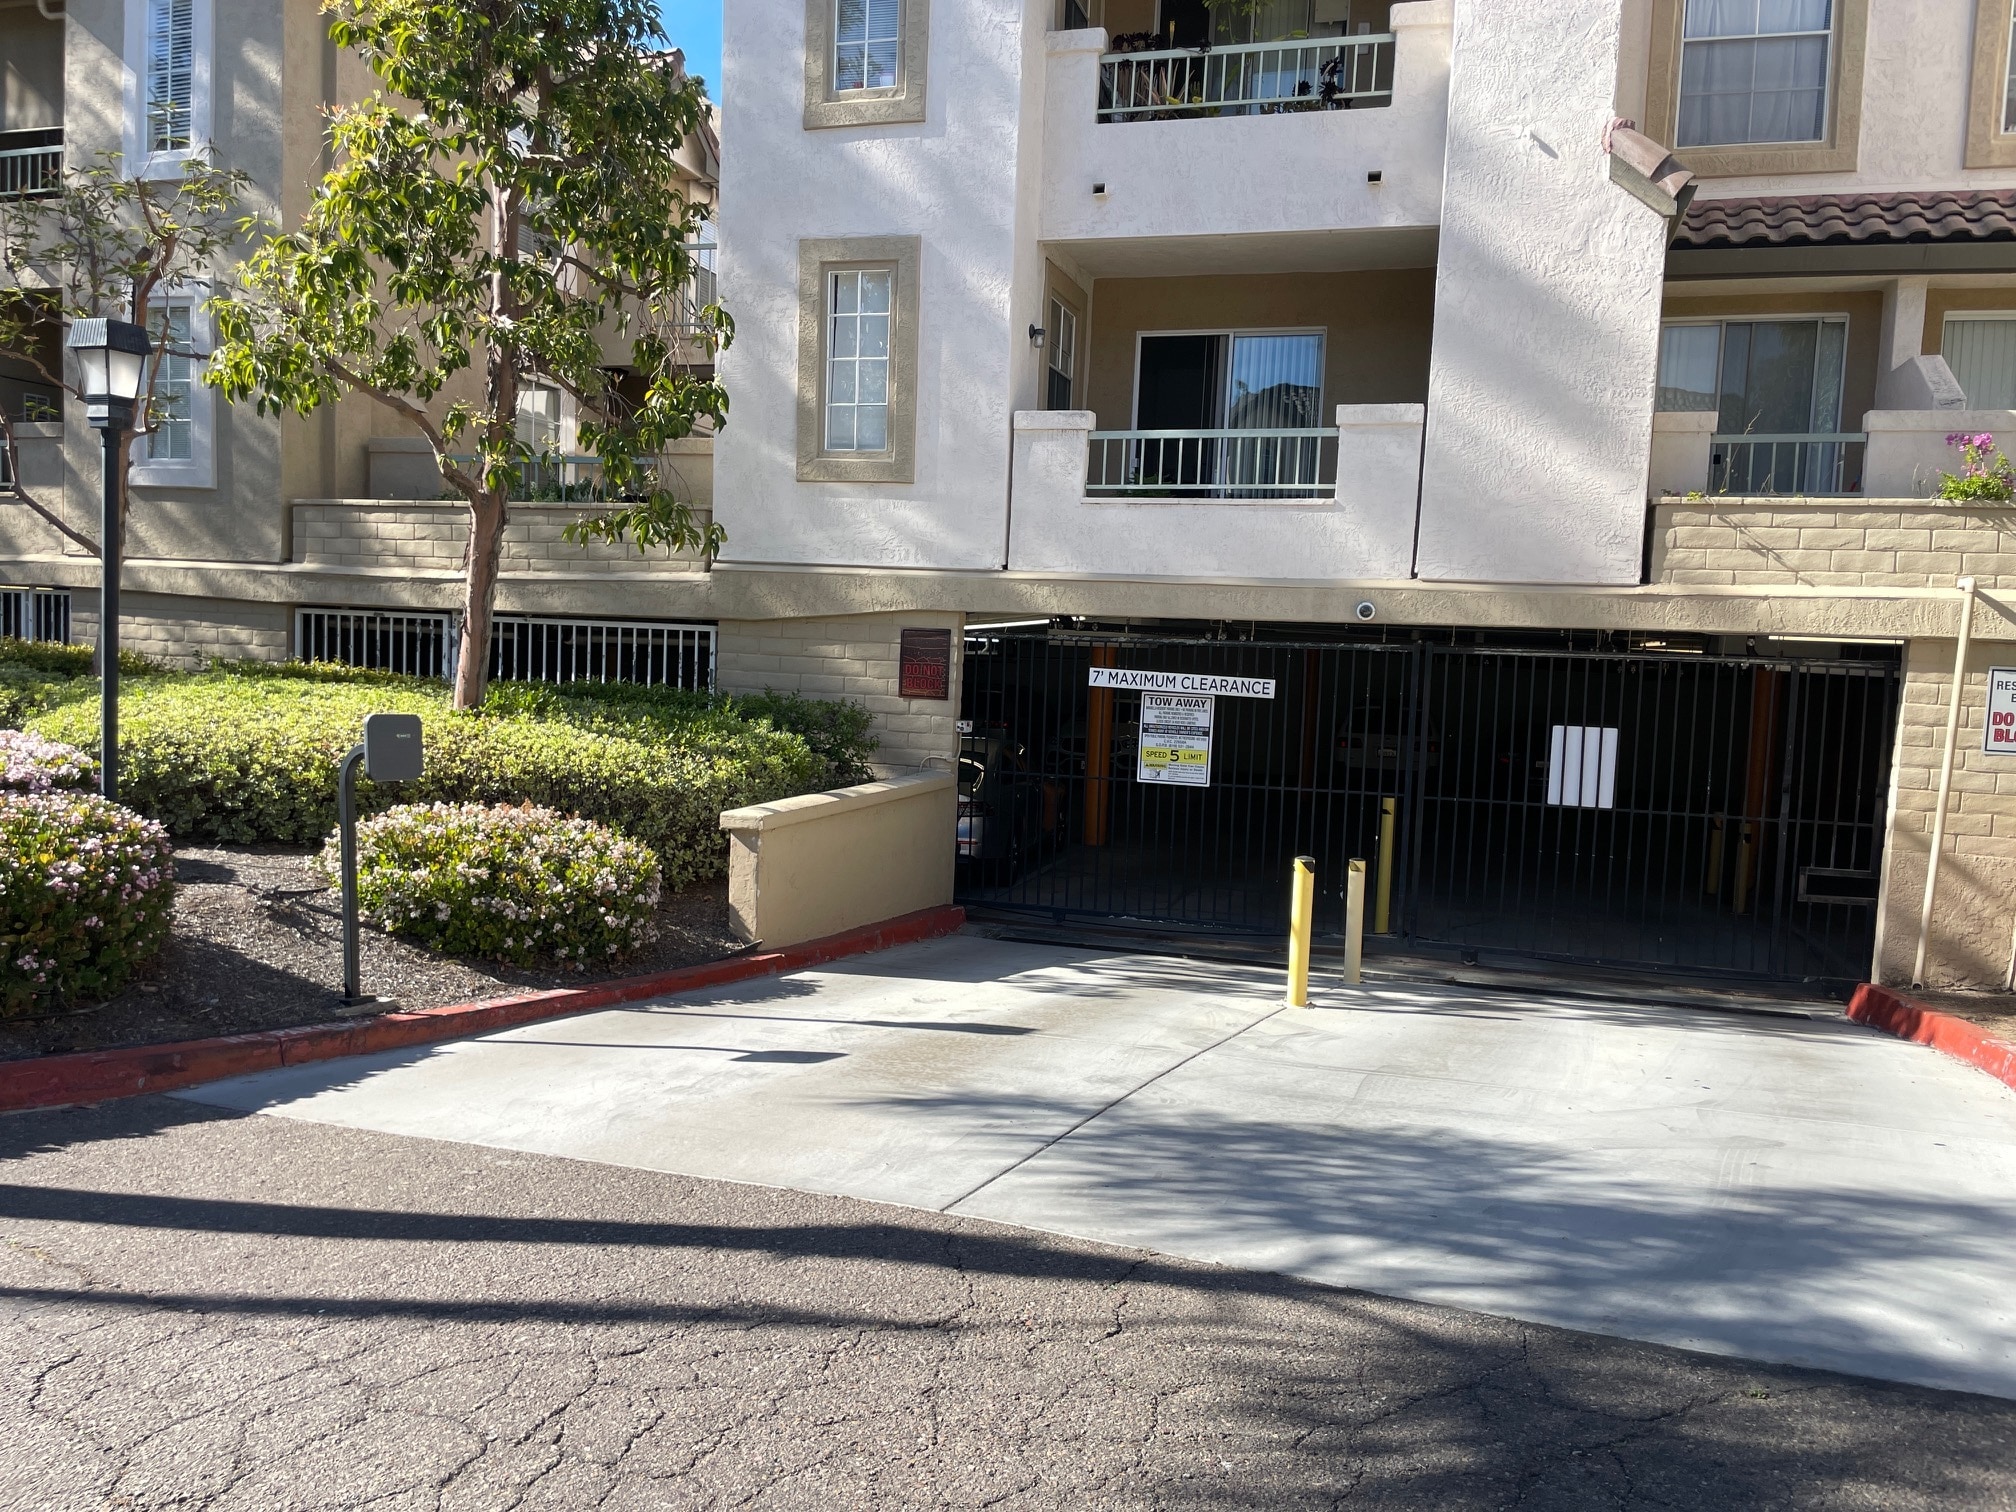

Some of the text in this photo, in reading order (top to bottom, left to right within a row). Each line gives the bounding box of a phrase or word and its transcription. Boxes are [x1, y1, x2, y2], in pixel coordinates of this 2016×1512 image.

[905, 665, 944, 676] DO NOT
[906, 678, 942, 689] BLOCK
[1108, 672, 1176, 688] MAXIMUM
[1181, 677, 1271, 695] CLEARANCE
[1148, 697, 1208, 708] TOW AWAY
[1992, 712, 2015, 726] DO
[1993, 729, 2016, 742] BL
[1145, 749, 1203, 762] SPEED 5 LIMIT
